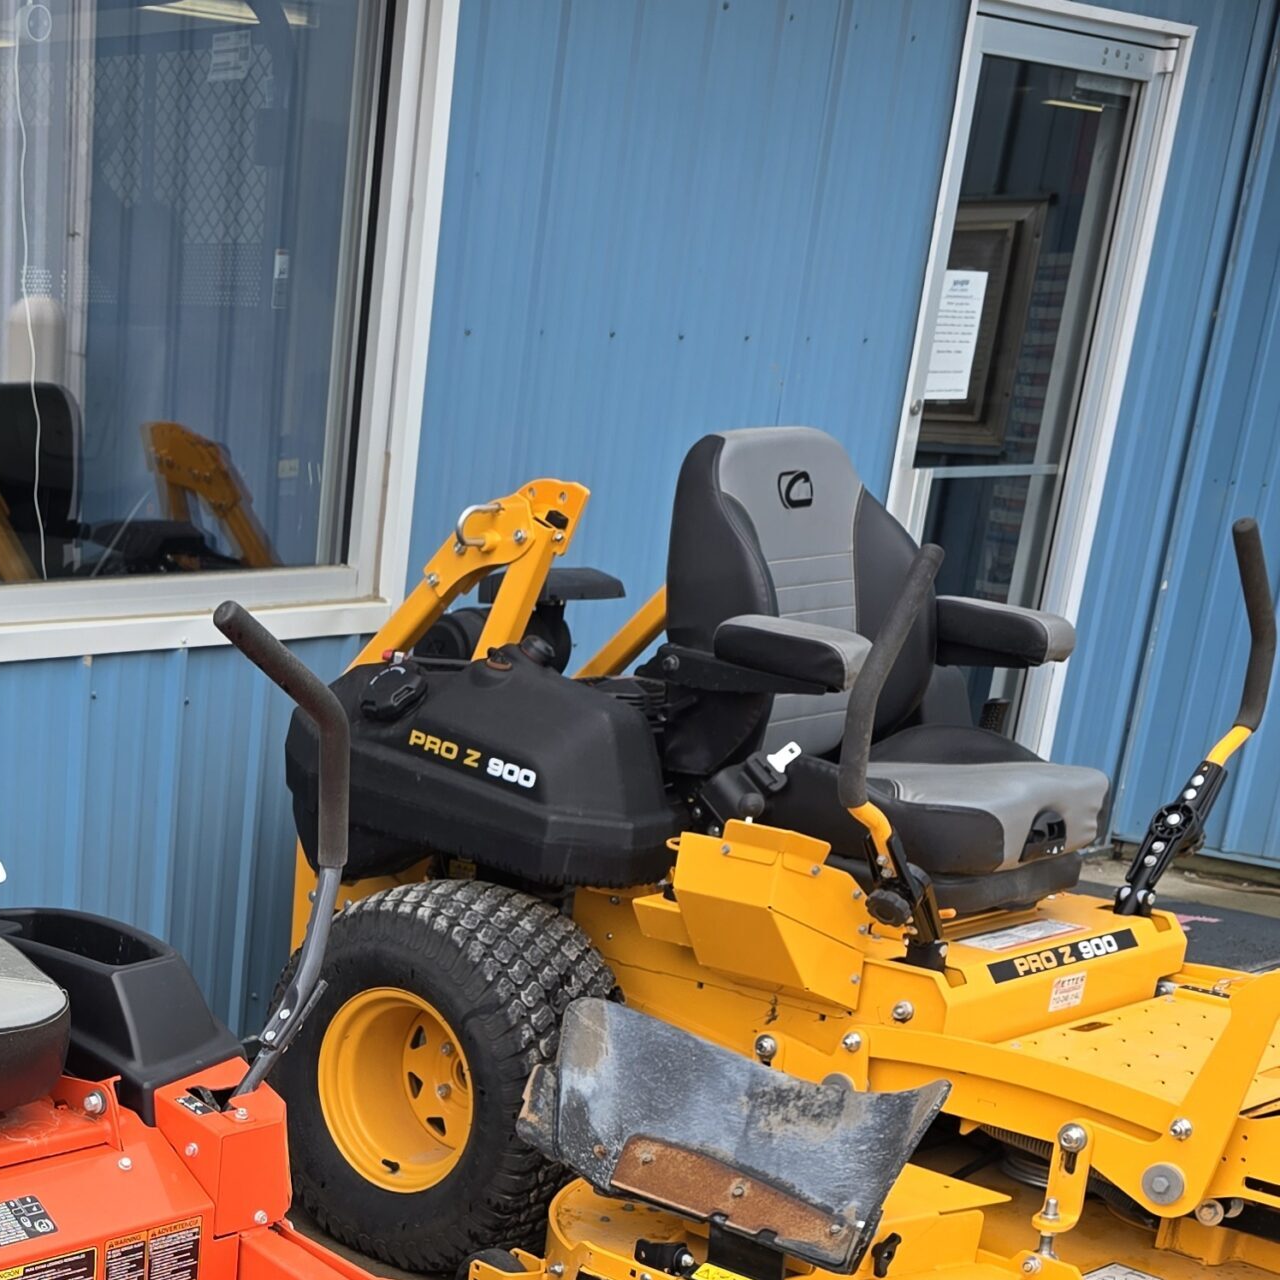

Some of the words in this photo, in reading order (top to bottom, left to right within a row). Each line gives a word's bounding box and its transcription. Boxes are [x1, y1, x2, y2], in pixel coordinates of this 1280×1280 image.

[408, 728, 459, 761] PRO
[463, 748, 482, 768] Z
[486, 757, 537, 789] 900
[1013, 951, 1057, 976] PRO
[1059, 945, 1077, 965] Z
[1077, 935, 1119, 959] 900
